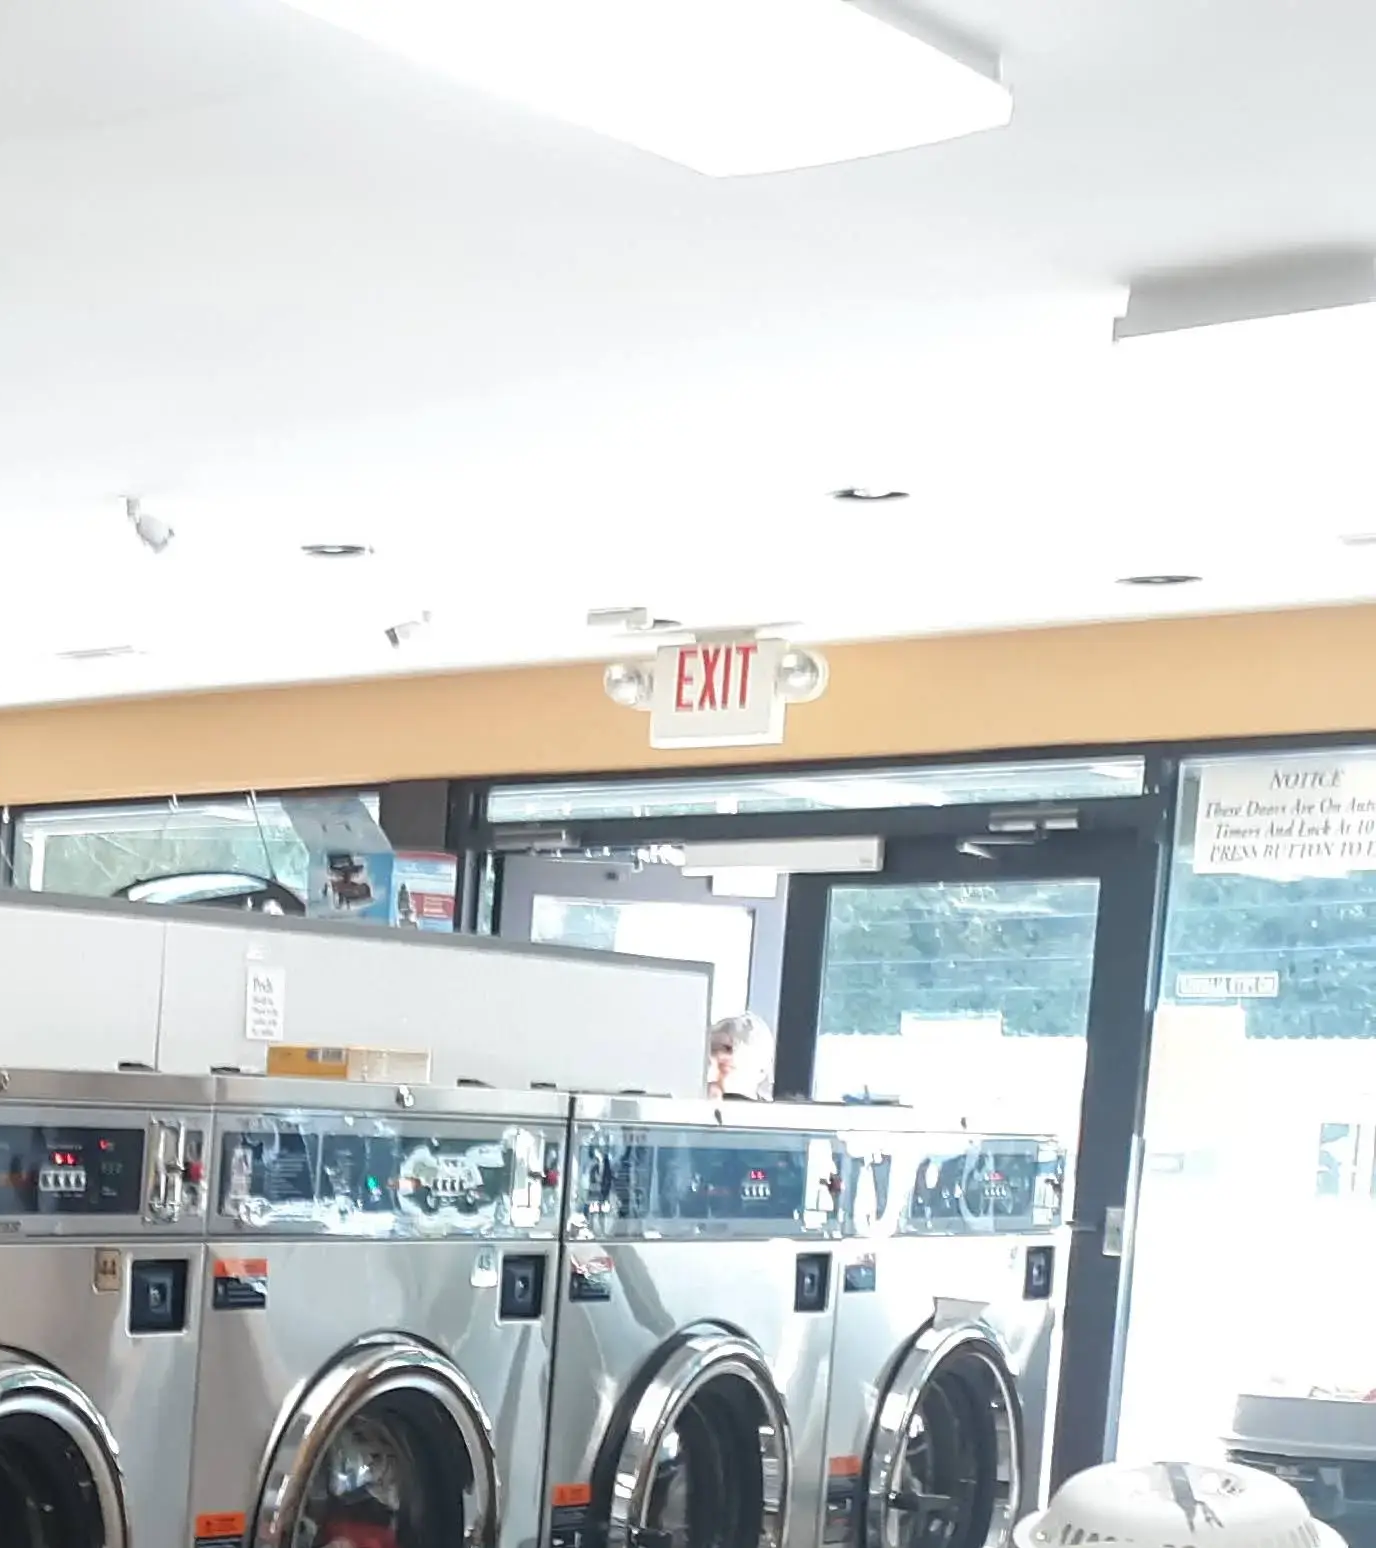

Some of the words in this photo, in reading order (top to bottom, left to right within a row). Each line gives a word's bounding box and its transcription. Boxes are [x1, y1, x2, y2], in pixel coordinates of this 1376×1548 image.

[675, 643, 758, 711] EXIT
[1270, 768, 1344, 790] NOTICE
[1206, 800, 1245, 818] These
[1247, 799, 1286, 817] Doors
[1216, 822, 1261, 840] Timers
[1265, 819, 1294, 838] And
[1298, 818, 1330, 837] Lock
[1210, 843, 1258, 863] PRESS
